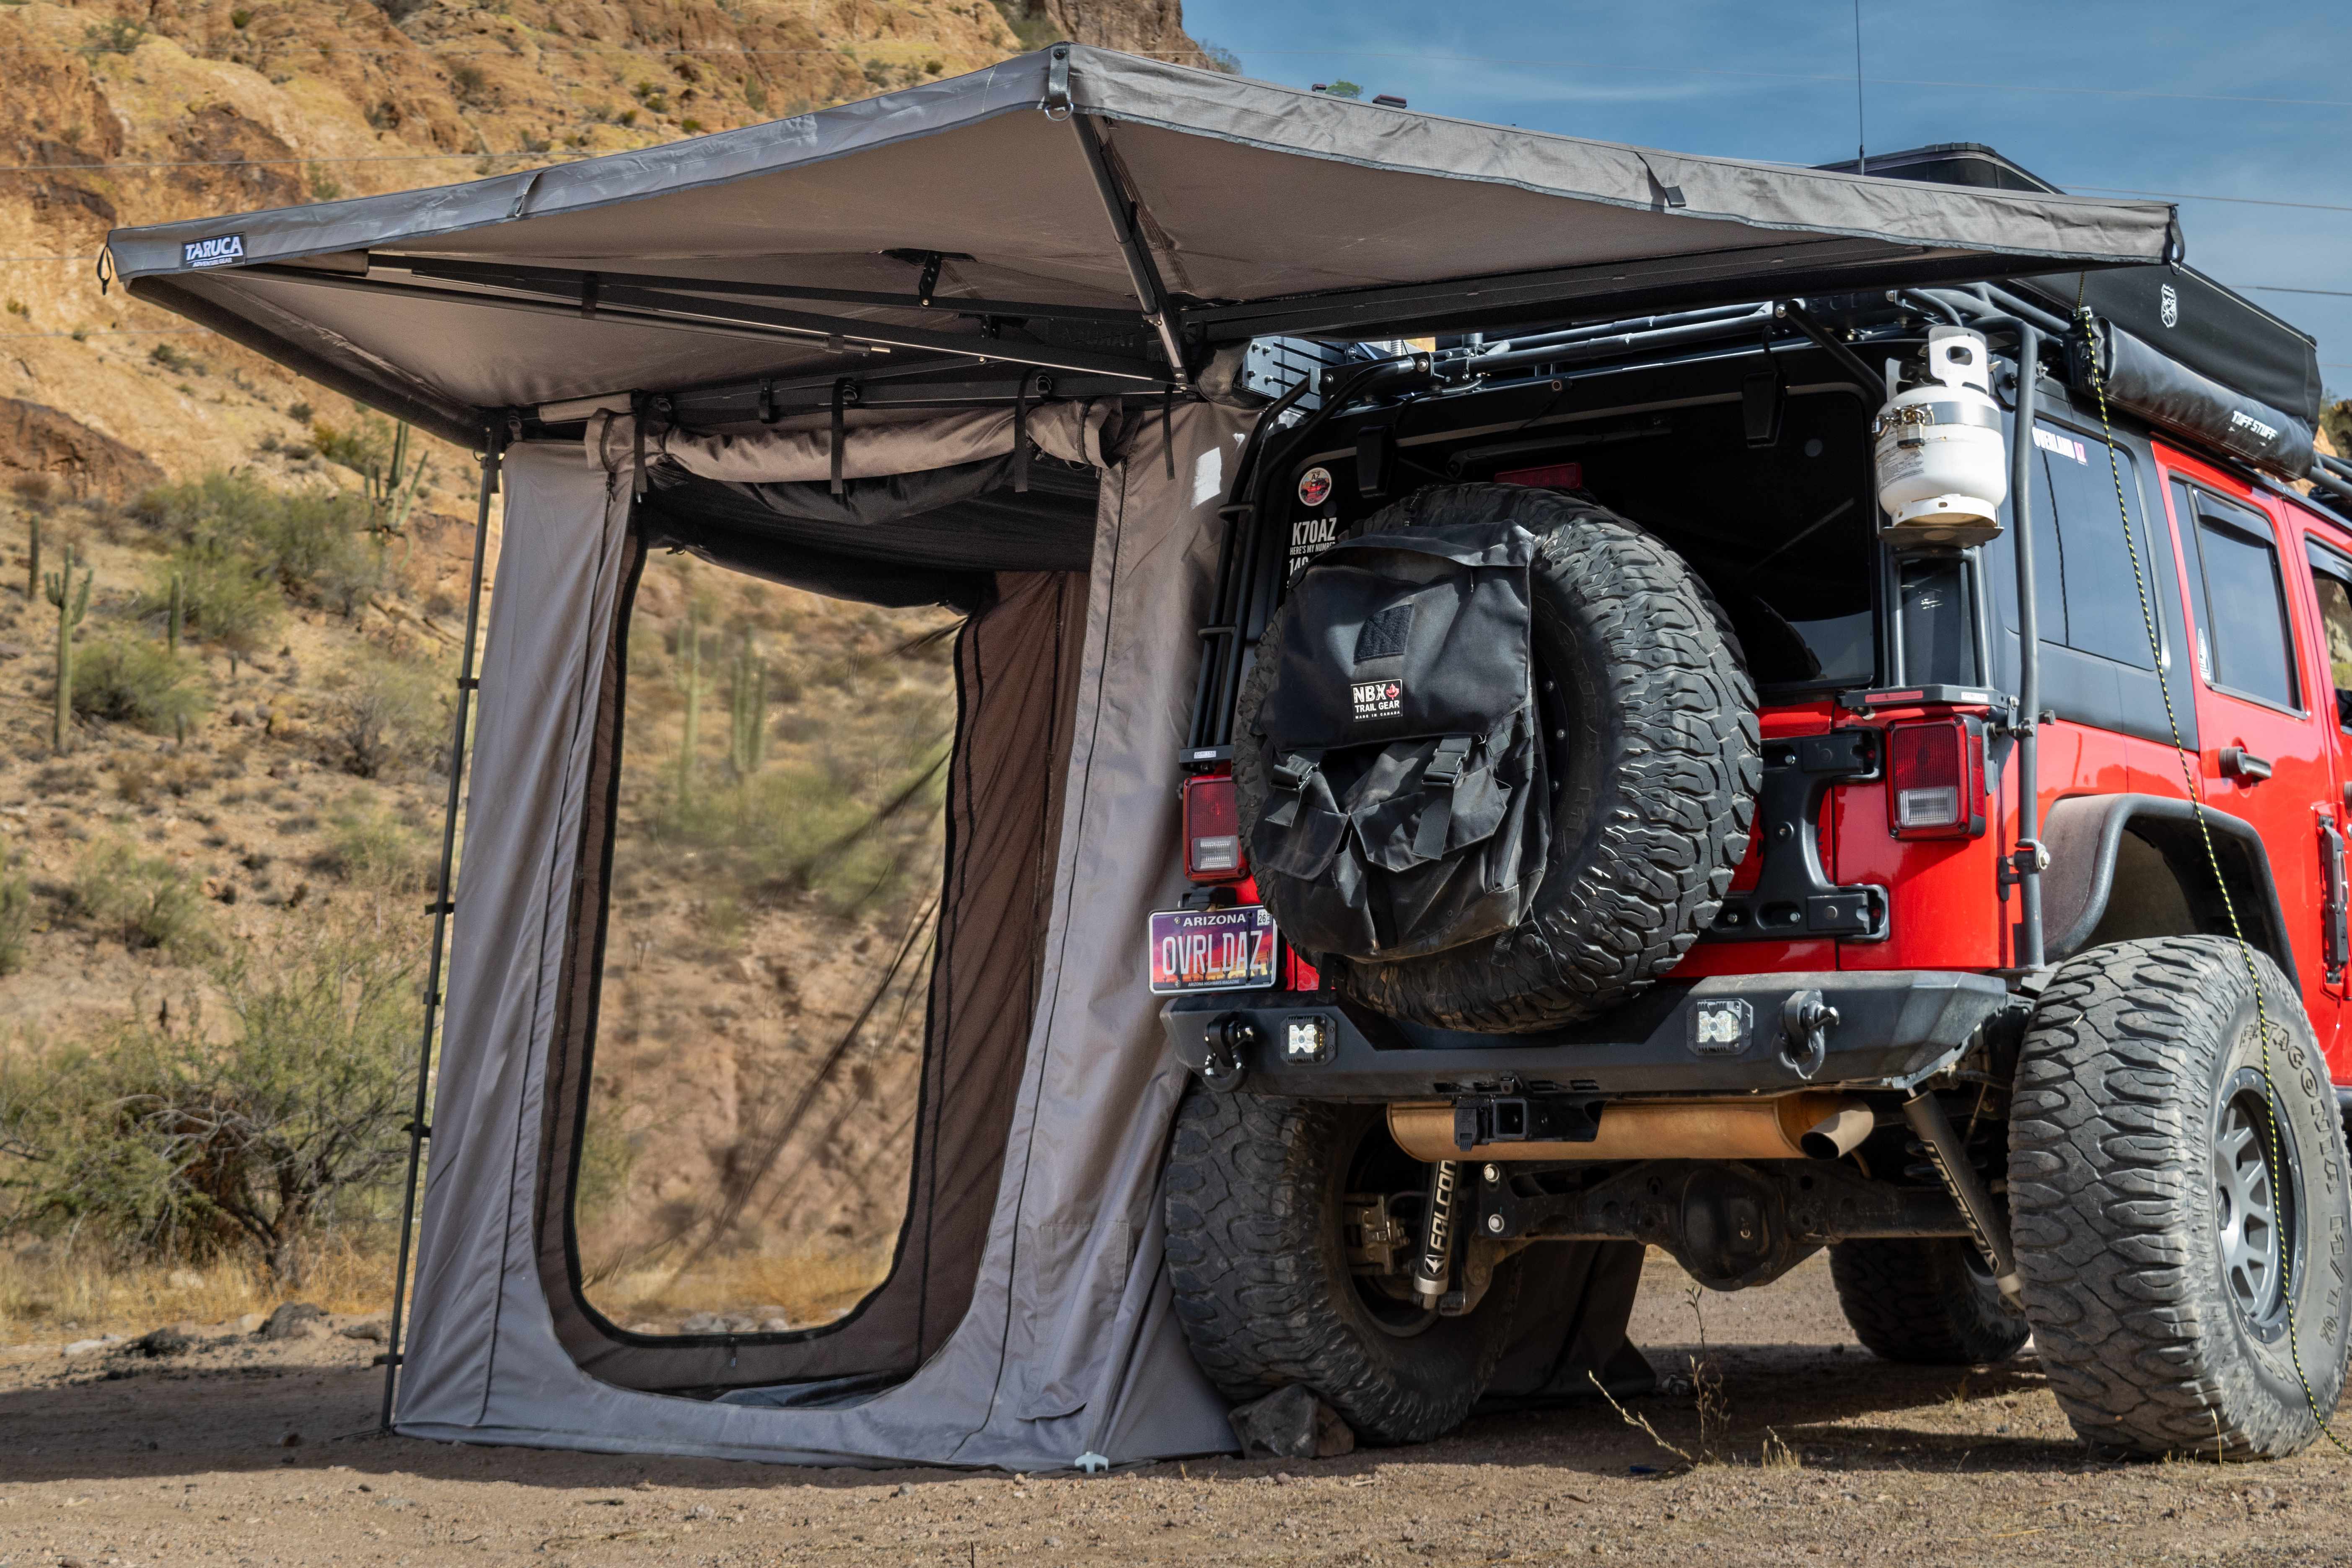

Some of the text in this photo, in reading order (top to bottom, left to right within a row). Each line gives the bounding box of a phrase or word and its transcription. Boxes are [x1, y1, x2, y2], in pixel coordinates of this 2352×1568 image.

[185, 236, 243, 260] TARUCA
[2231, 410, 2278, 441] TUFF STUFF
[1290, 545, 1306, 555] HERE'S
[1307, 544, 1315, 553] MY
[1352, 684, 1386, 703] NBX
[1355, 700, 1400, 713] TRAIL GEAR
[1183, 913, 1246, 927] ARIZONA
[1259, 914, 1266, 923] 26
